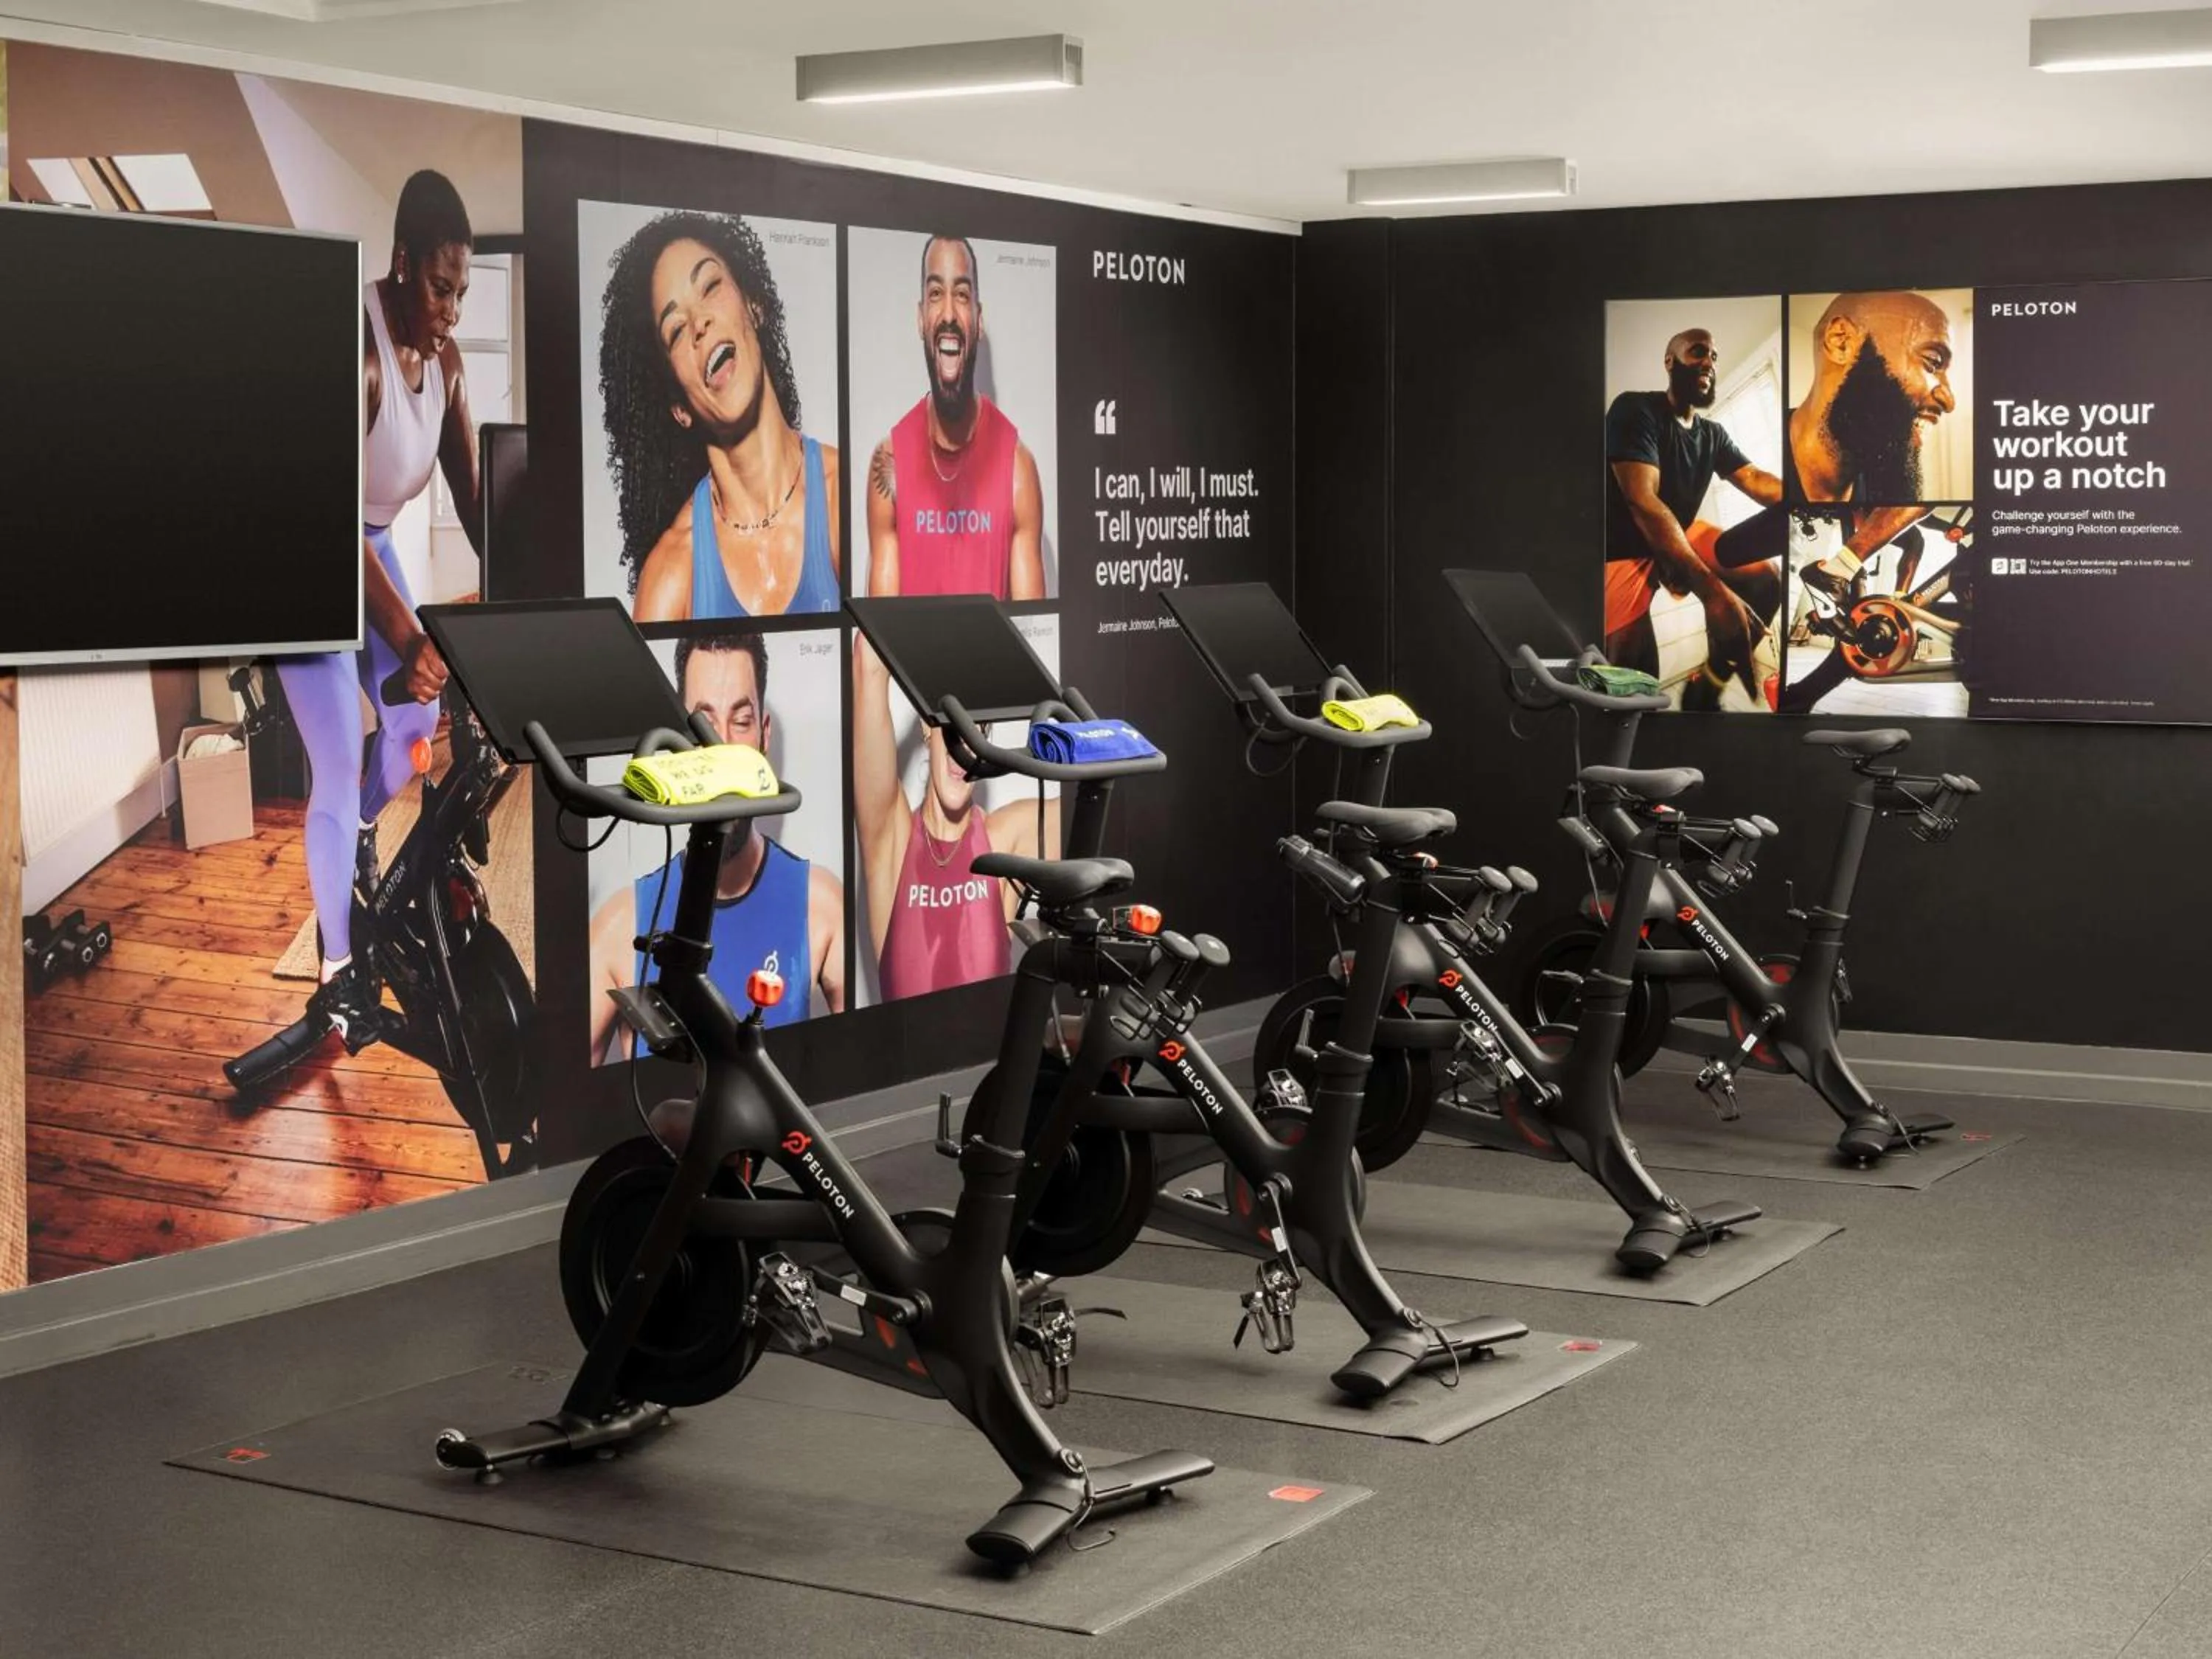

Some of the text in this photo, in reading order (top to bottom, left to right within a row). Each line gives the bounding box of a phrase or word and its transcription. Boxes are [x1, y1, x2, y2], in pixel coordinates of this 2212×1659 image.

[1093, 250, 1185, 285] PELOTON
[1991, 302, 2077, 316] PELOTON
[1993, 399, 2154, 432] Take your
[1993, 431, 2128, 458] workout
[1095, 466, 1259, 505] I can, I will, I must.
[1993, 461, 2166, 495] up a notch
[916, 509, 992, 535] PELOTON
[1095, 507, 1250, 549] Tell yourself that
[1992, 510, 2135, 522] Challenge yourself with the
[1992, 524, 2183, 536] game-changing Peloton experience.
[1096, 552, 1189, 591] everyday.
[908, 880, 989, 908] PELOTON
[1691, 919, 1729, 961] PELOTON
[1455, 984, 1498, 1032] PELOTON
[1177, 1058, 1224, 1116] PELOTON
[801, 1152, 855, 1219] PELOTON
